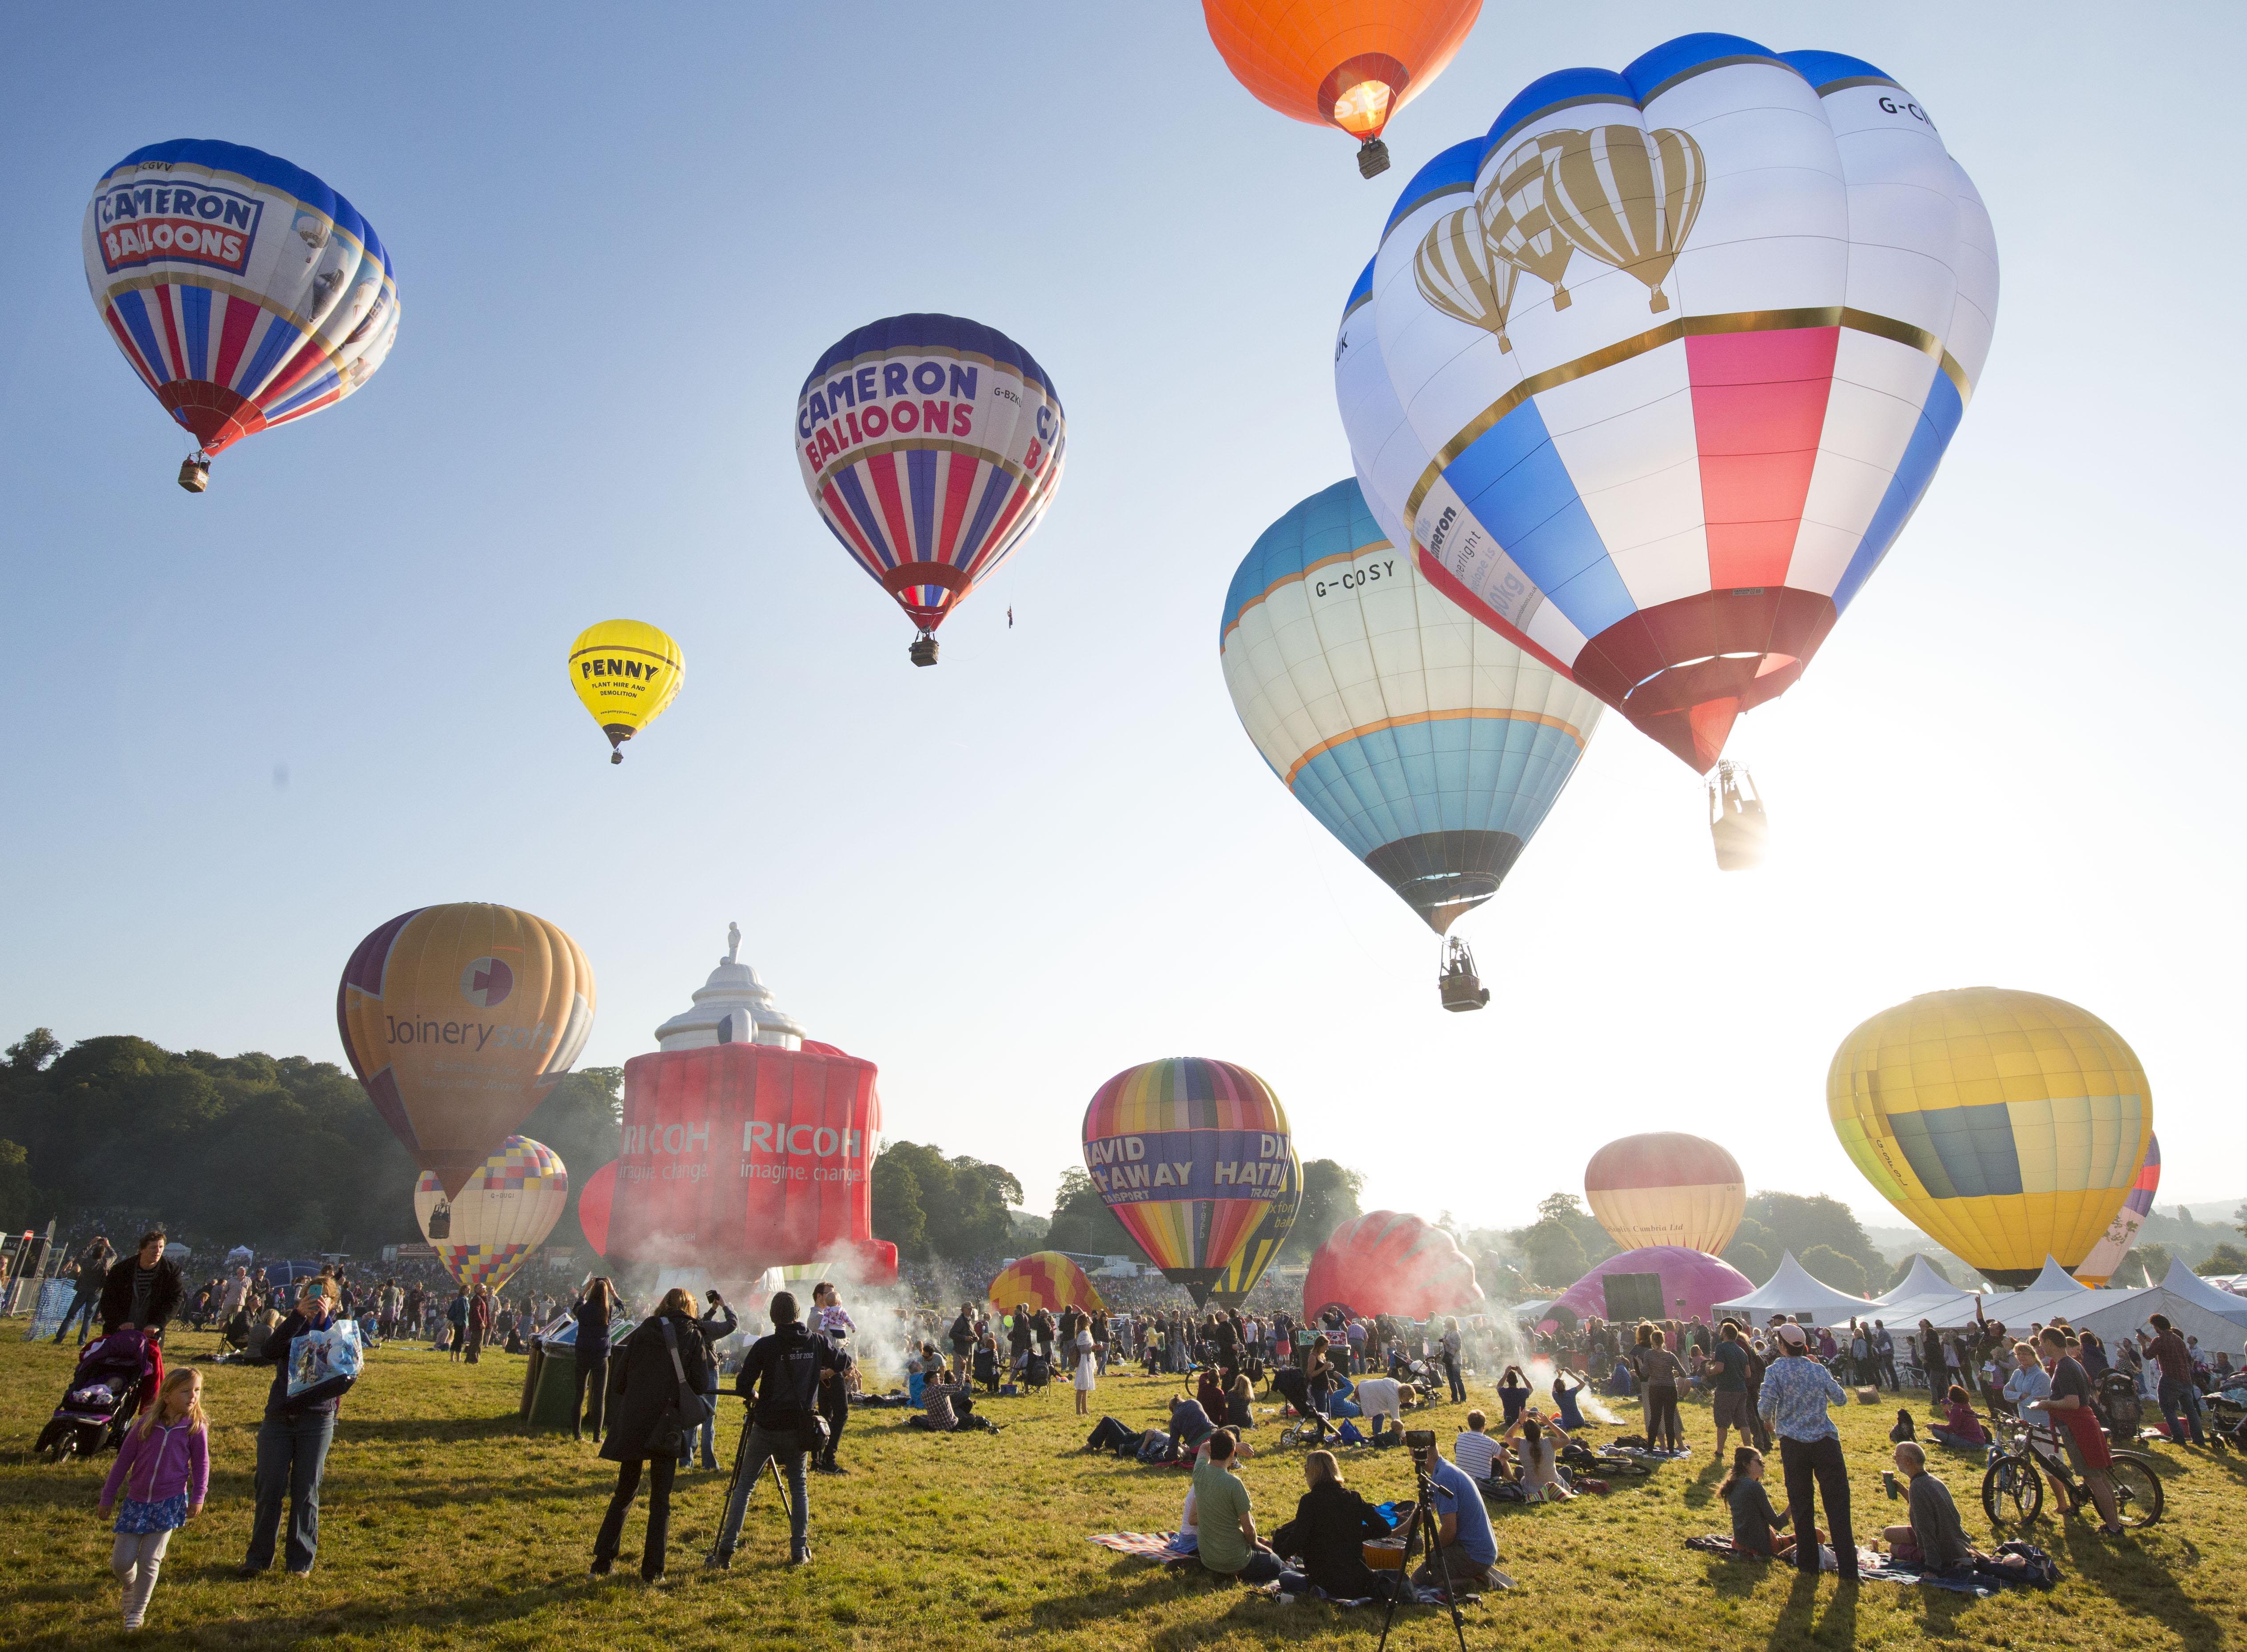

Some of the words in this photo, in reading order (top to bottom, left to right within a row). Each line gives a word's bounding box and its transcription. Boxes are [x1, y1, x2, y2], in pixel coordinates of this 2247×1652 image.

[103, 188, 251, 230] CAMERON
[106, 224, 243, 262] BALLOONS
[799, 362, 977, 438] CAMERON
[994, 387, 1022, 407] G-BZKU
[805, 400, 974, 474] BALLOONS
[1482, 546, 1496, 560] is
[1316, 560, 1394, 597] G-COSY
[582, 659, 659, 682] PENNY
[623, 1122, 710, 1154] RICOH
[743, 1121, 861, 1158] RICOH
[741, 1159, 808, 1184] imagine.
[814, 1163, 865, 1186] change.
